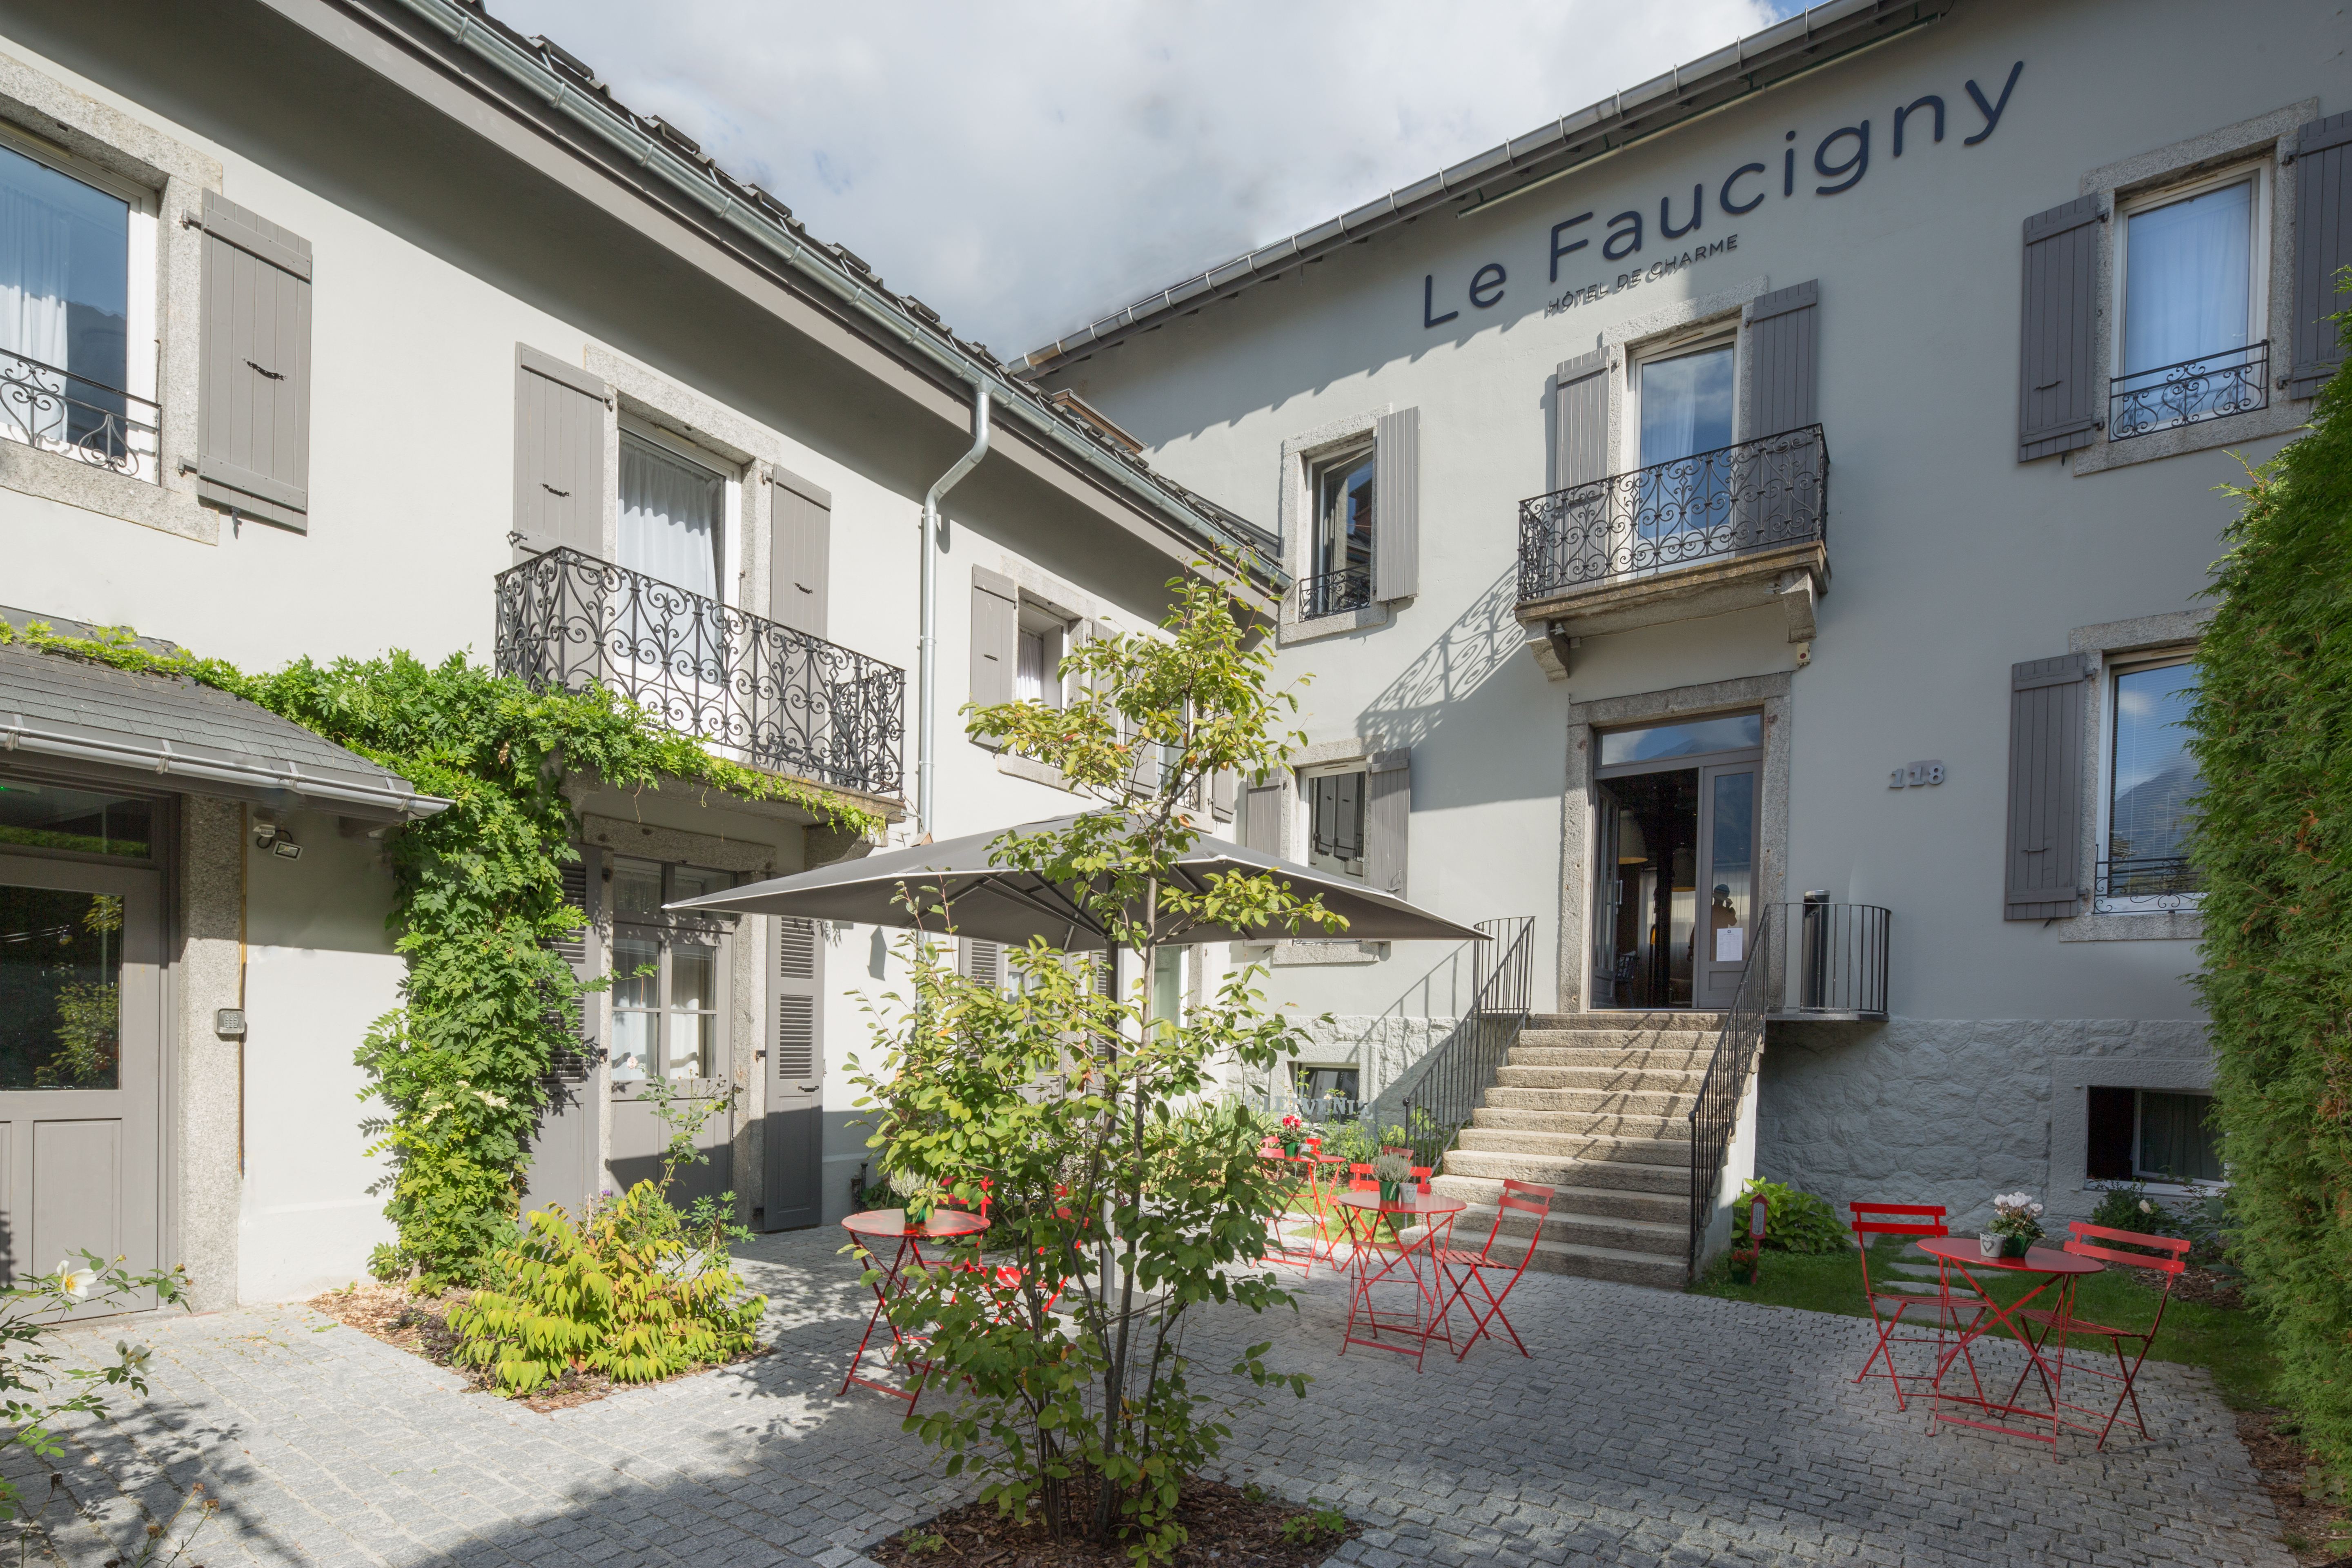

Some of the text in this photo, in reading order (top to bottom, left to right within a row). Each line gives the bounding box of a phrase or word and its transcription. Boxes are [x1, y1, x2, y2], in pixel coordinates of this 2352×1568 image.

[1424, 60, 2023, 328] Le Faucigny
[1549, 234, 1738, 313] HÔTEL DE CHARME
[1889, 764, 1944, 788] 118
[1244, 1095, 1374, 1120] BIENVENUE
